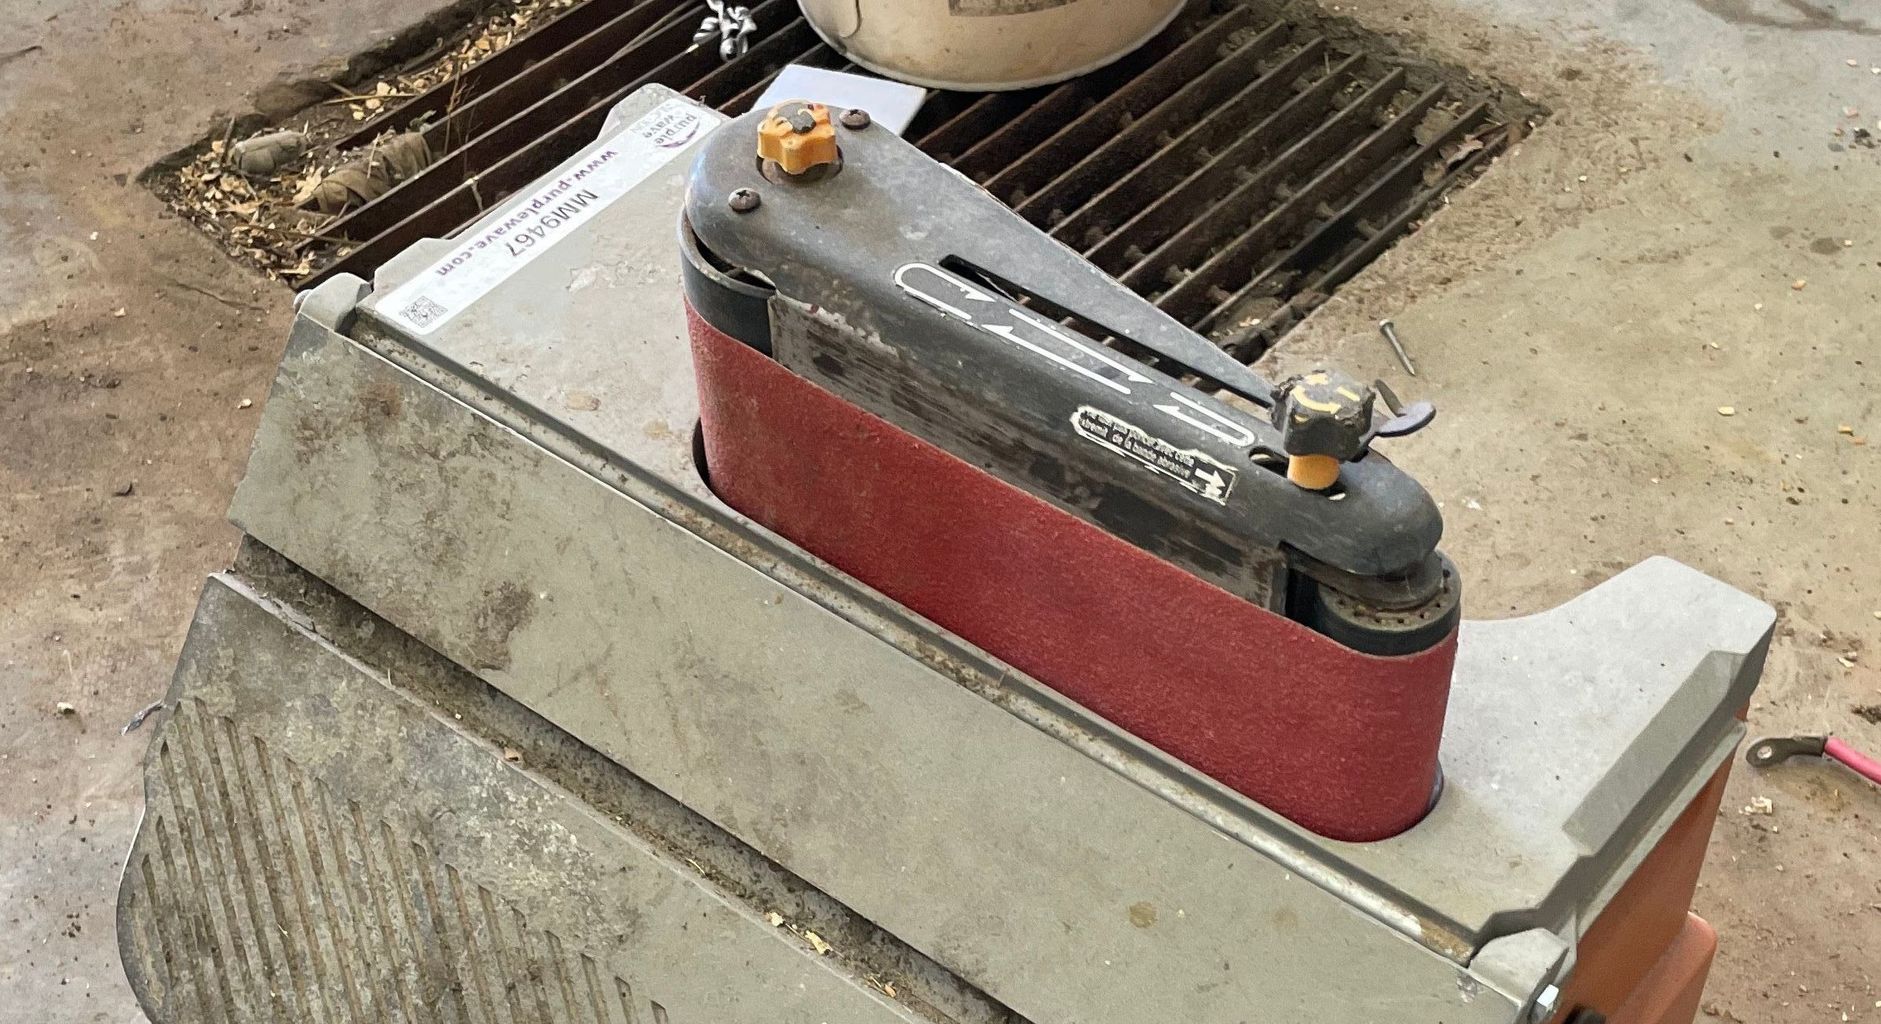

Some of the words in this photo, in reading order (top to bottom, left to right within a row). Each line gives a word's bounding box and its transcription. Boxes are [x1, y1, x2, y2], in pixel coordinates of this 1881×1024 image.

[653, 112, 698, 146] purple
[436, 149, 619, 277] www.purplewave.com
[505, 187, 600, 258] MM9467
